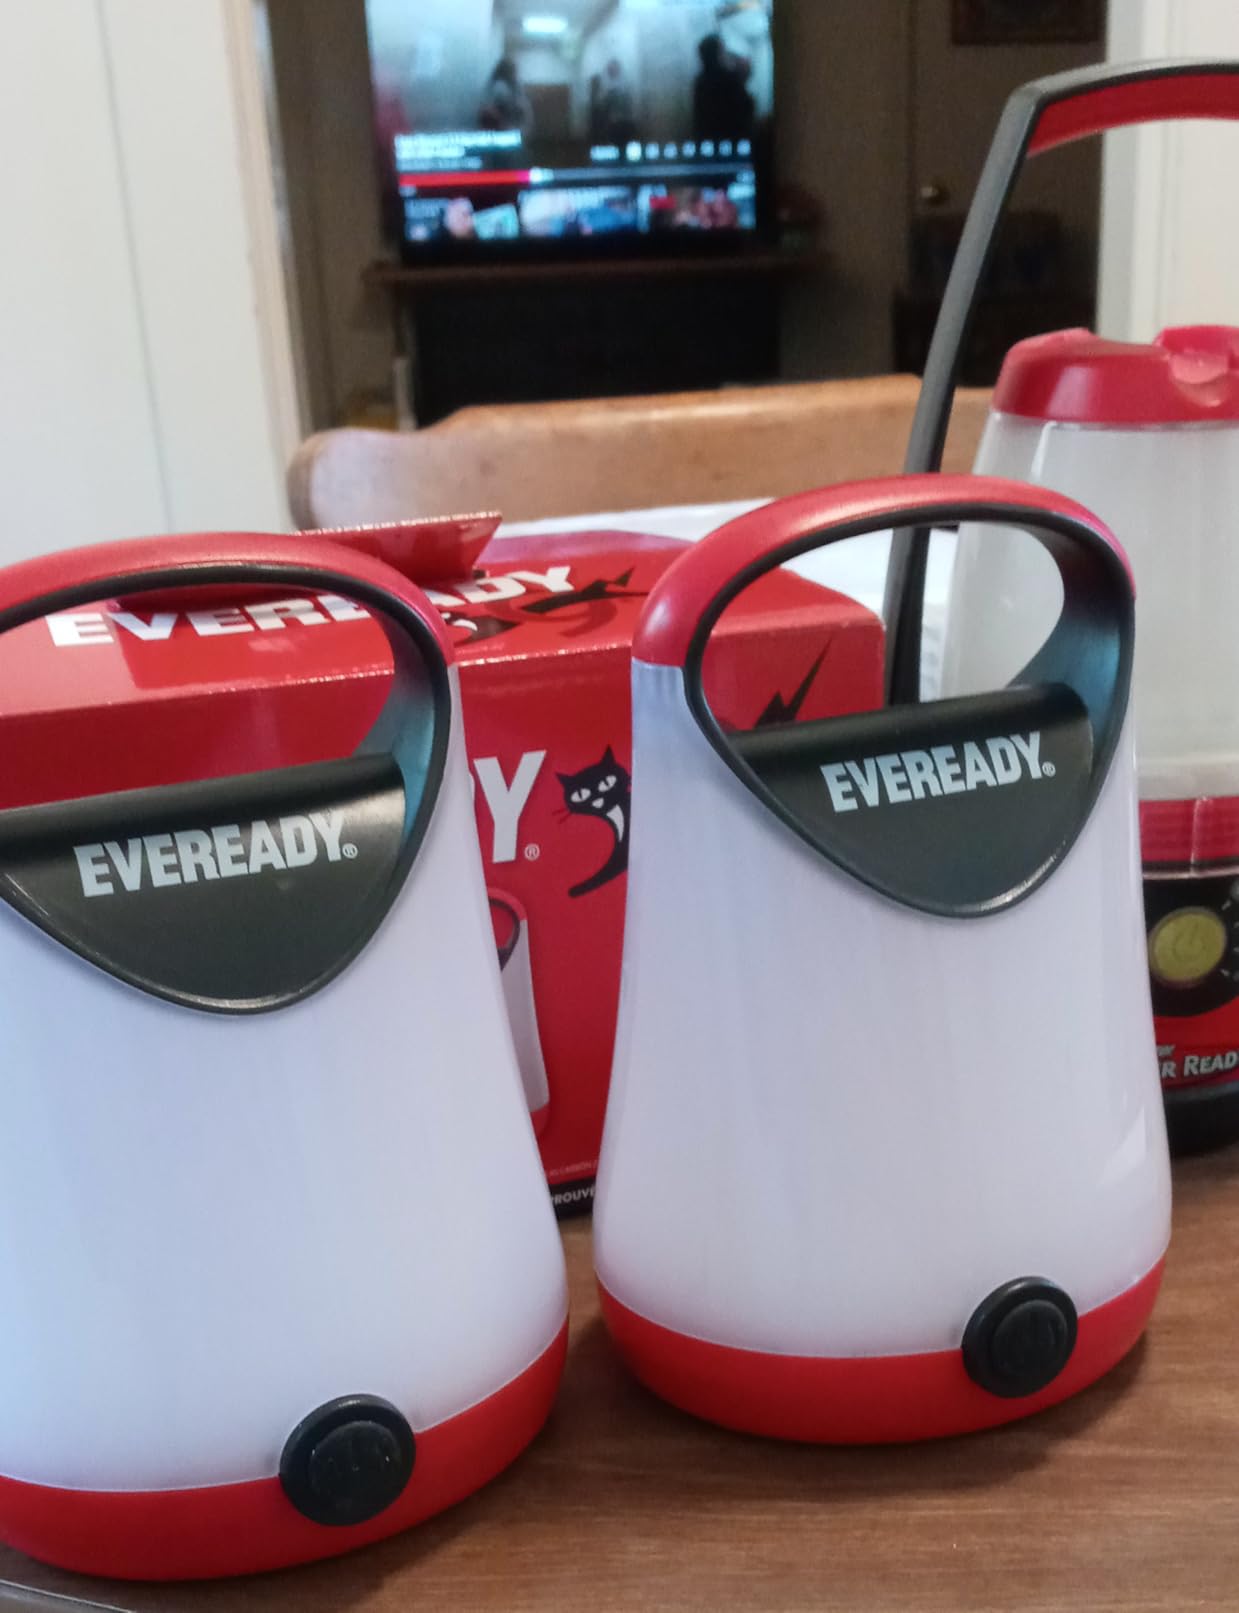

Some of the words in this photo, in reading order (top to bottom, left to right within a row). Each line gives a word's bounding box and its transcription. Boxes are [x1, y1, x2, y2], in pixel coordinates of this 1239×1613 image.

[472, 749, 546, 863] Y
[820, 731, 1042, 812] EVEREADY
[73, 809, 345, 897] EVEREADY
[1161, 1061, 1177, 1079] R
[1183, 1050, 1239, 1077] READ
